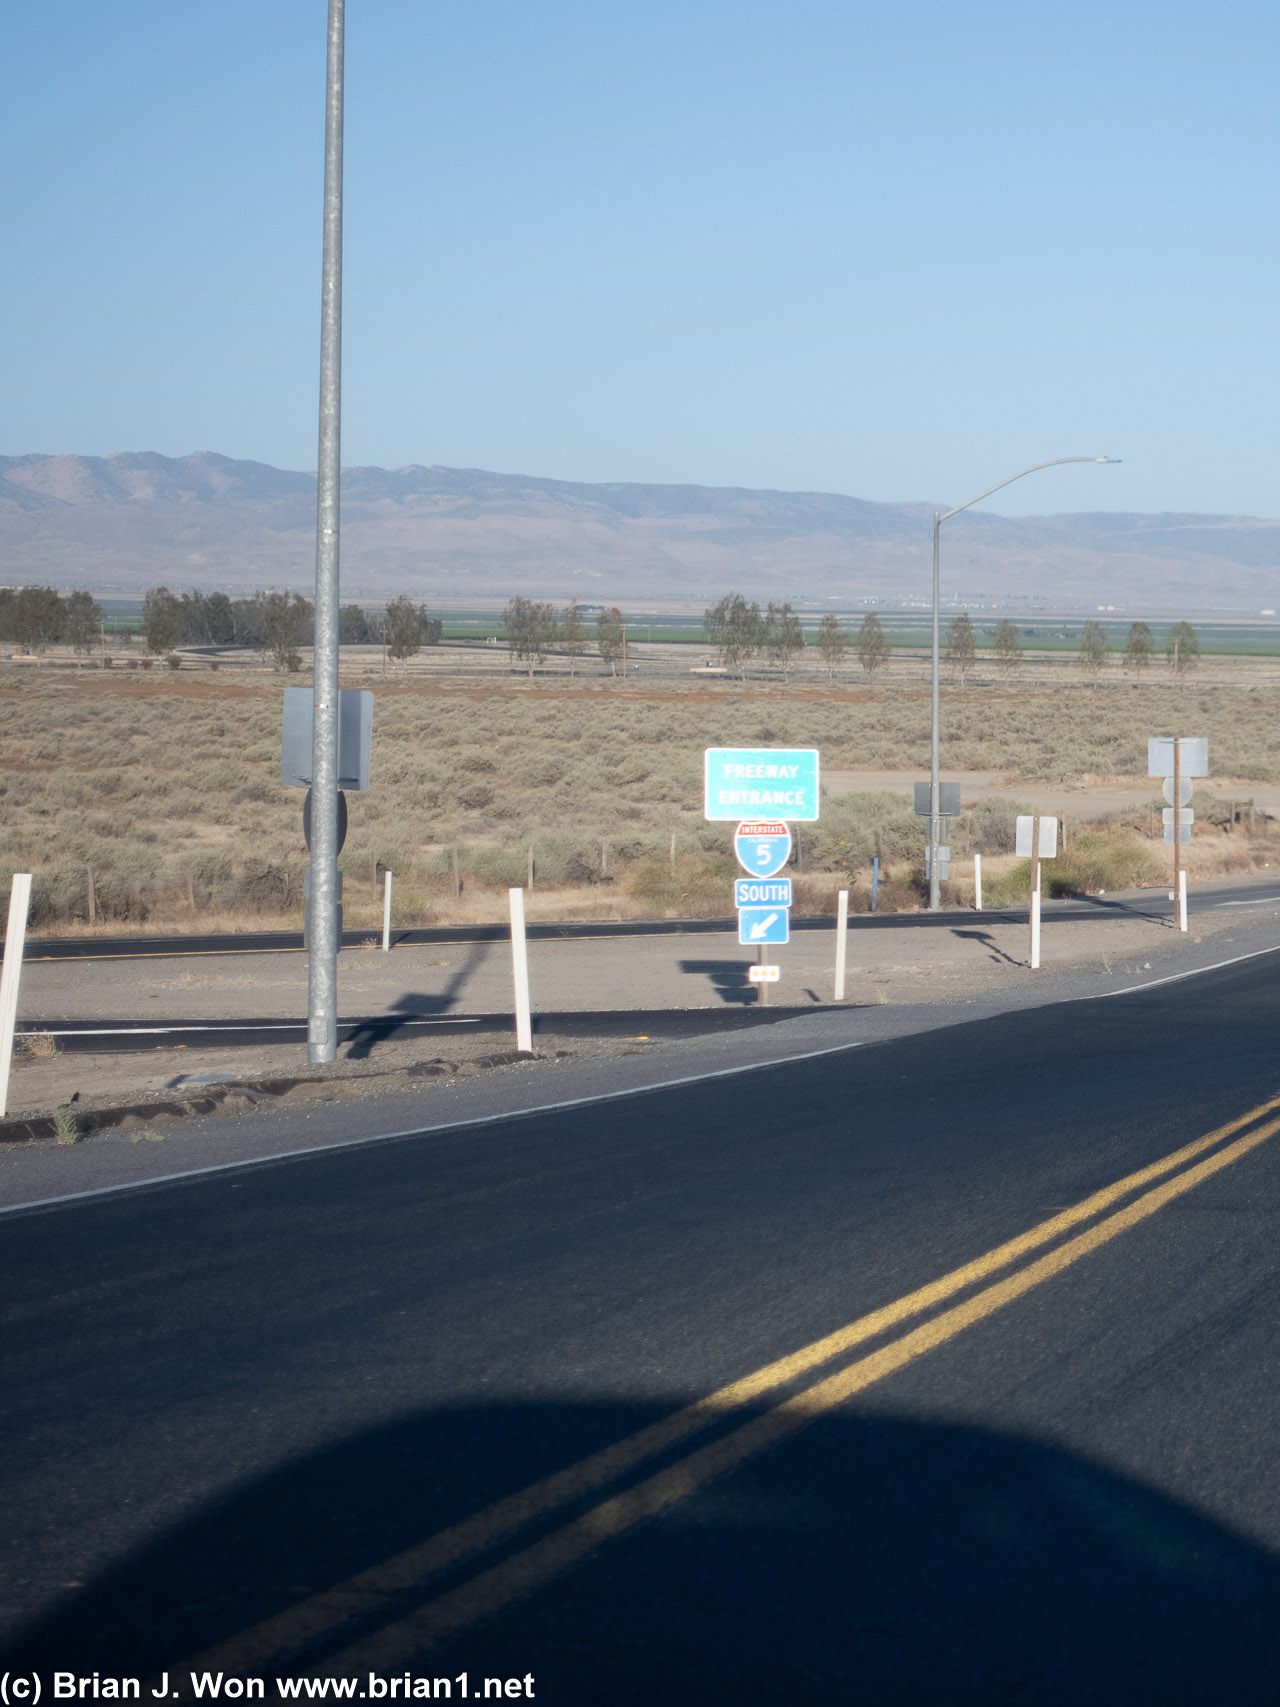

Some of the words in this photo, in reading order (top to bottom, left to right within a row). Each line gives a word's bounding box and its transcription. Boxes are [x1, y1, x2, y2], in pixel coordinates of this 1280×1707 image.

[724, 764, 799, 778] FREEWAY
[718, 790, 805, 805] ENTRANCE
[742, 826, 784, 834] INTERSTATE
[757, 844, 771, 865] 5
[739, 884, 788, 902] SOUTH
